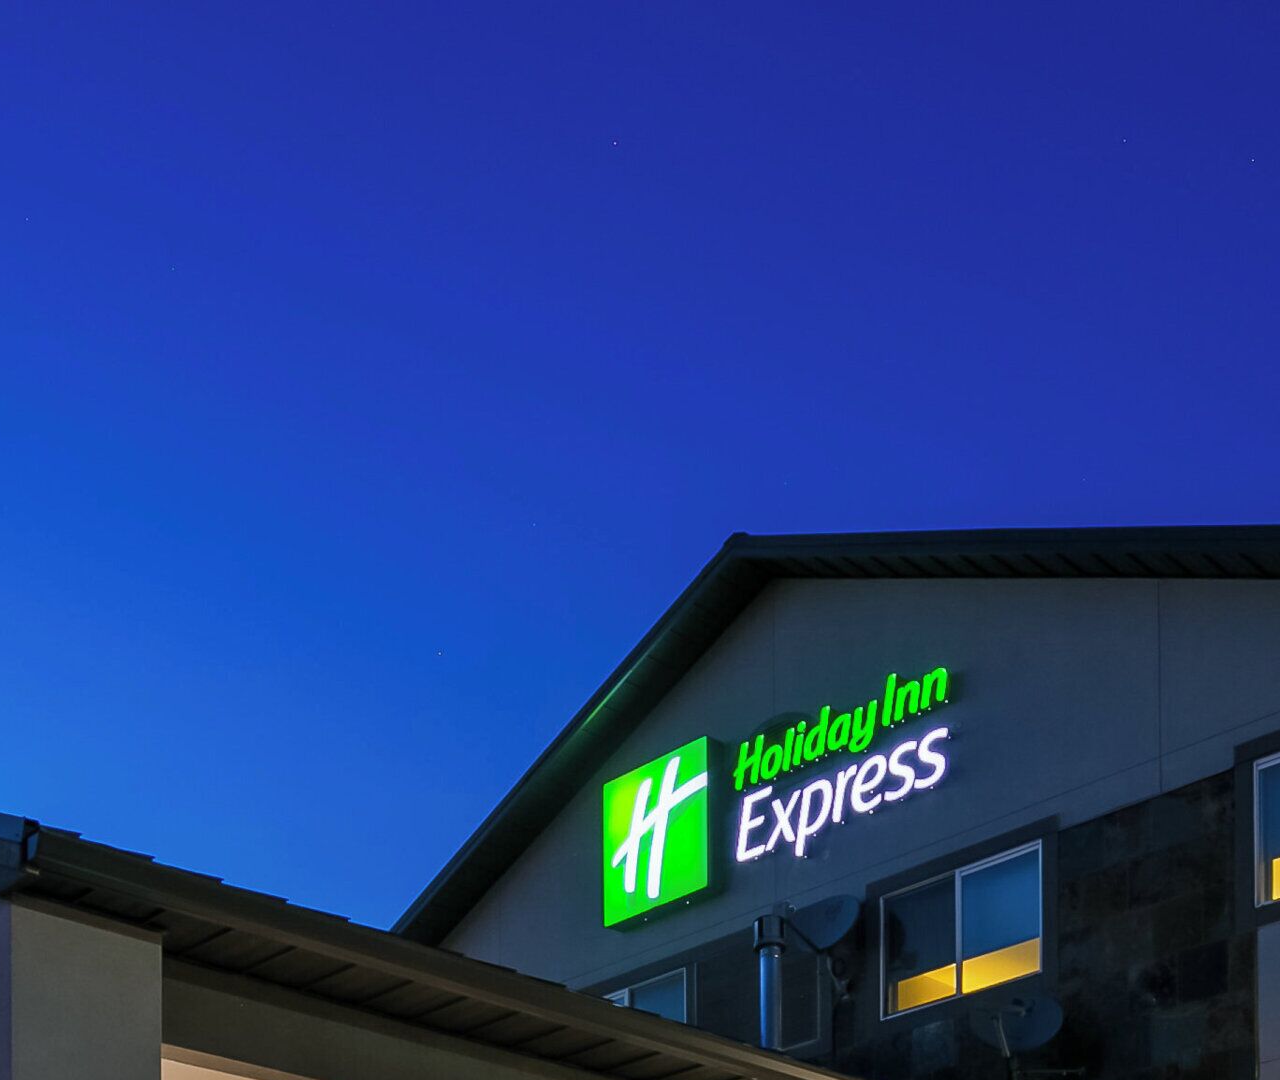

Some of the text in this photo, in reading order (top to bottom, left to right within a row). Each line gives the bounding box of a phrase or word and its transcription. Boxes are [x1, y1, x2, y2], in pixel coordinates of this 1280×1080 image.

[734, 667, 948, 790] Holiday Inn
[736, 727, 950, 863] Express
